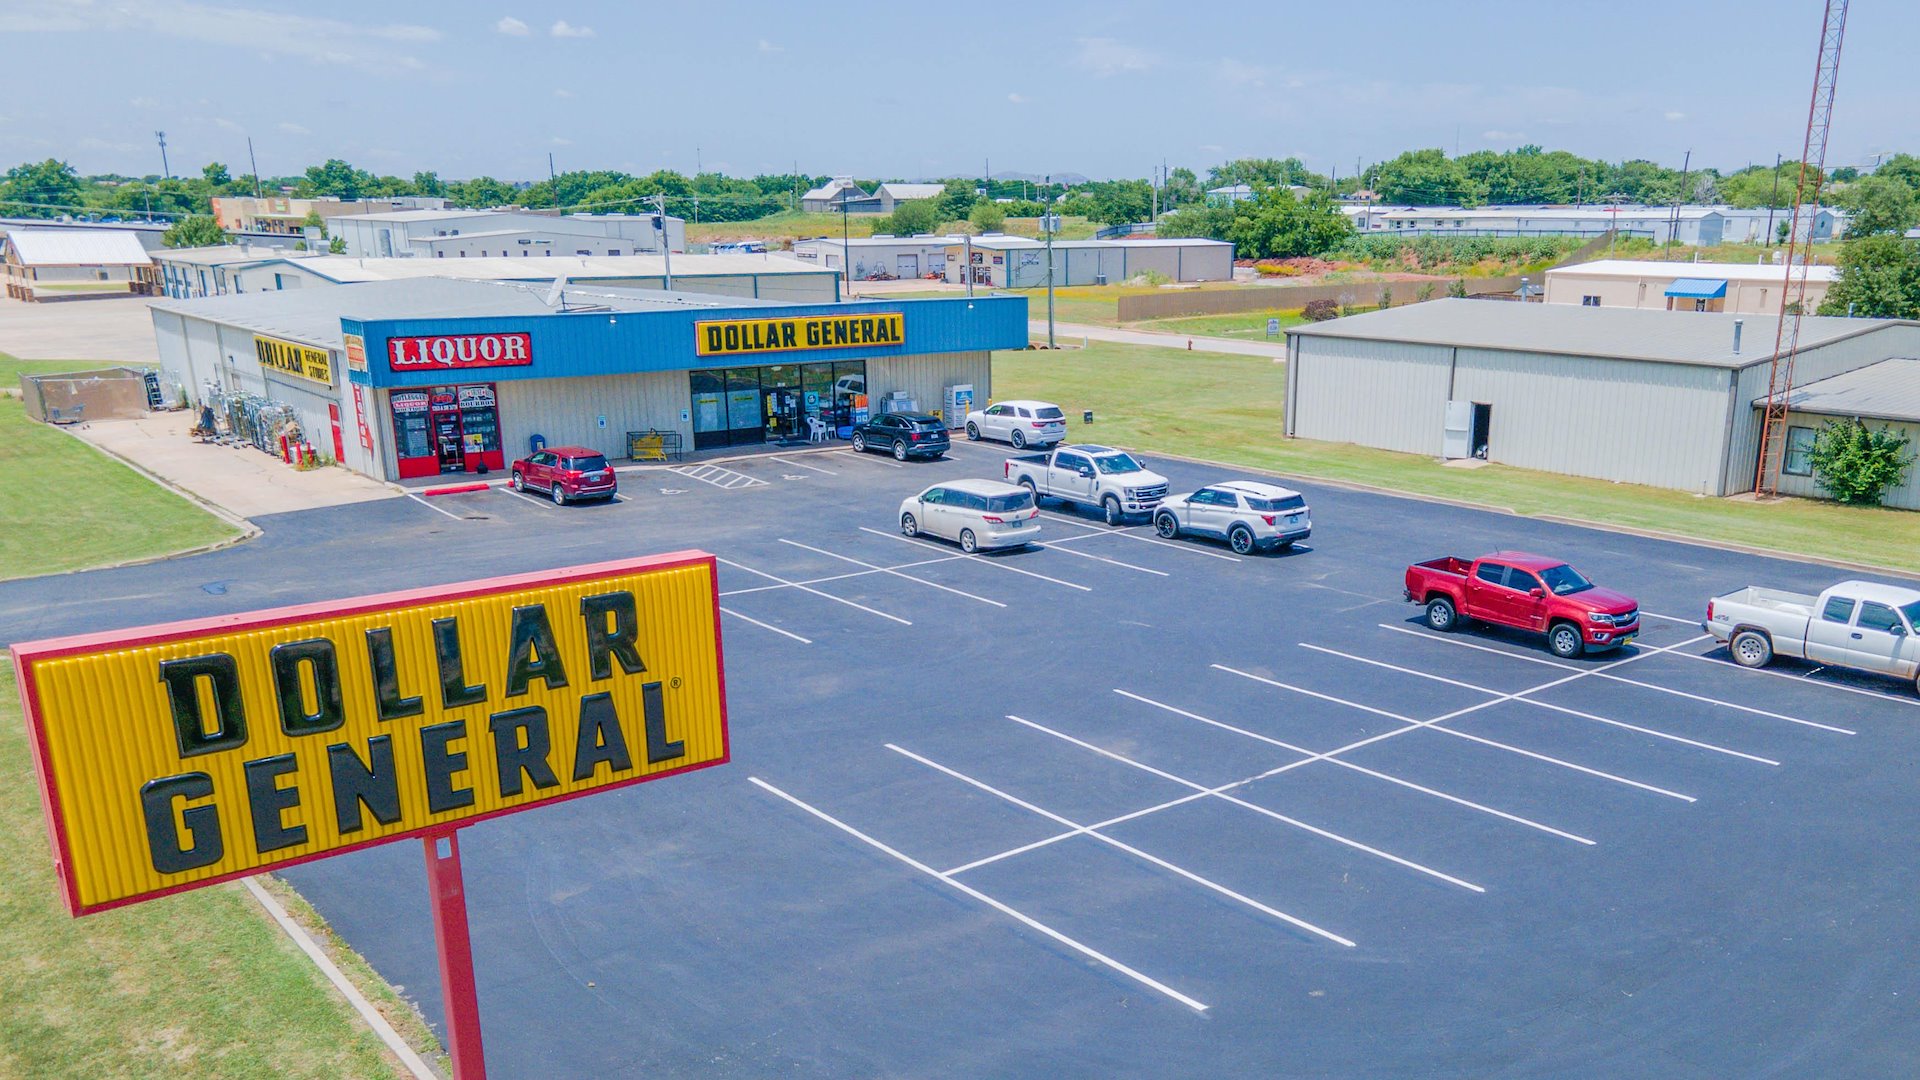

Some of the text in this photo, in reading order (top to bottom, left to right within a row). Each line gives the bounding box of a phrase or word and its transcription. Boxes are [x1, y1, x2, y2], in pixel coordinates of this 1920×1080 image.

[392, 336, 527, 367] LIQUOR
[706, 317, 901, 352] DOLLAR GENERAL
[255, 339, 304, 375] DOLLAR
[304, 349, 329, 366] GENERAL
[159, 590, 647, 759] DOLLAR
